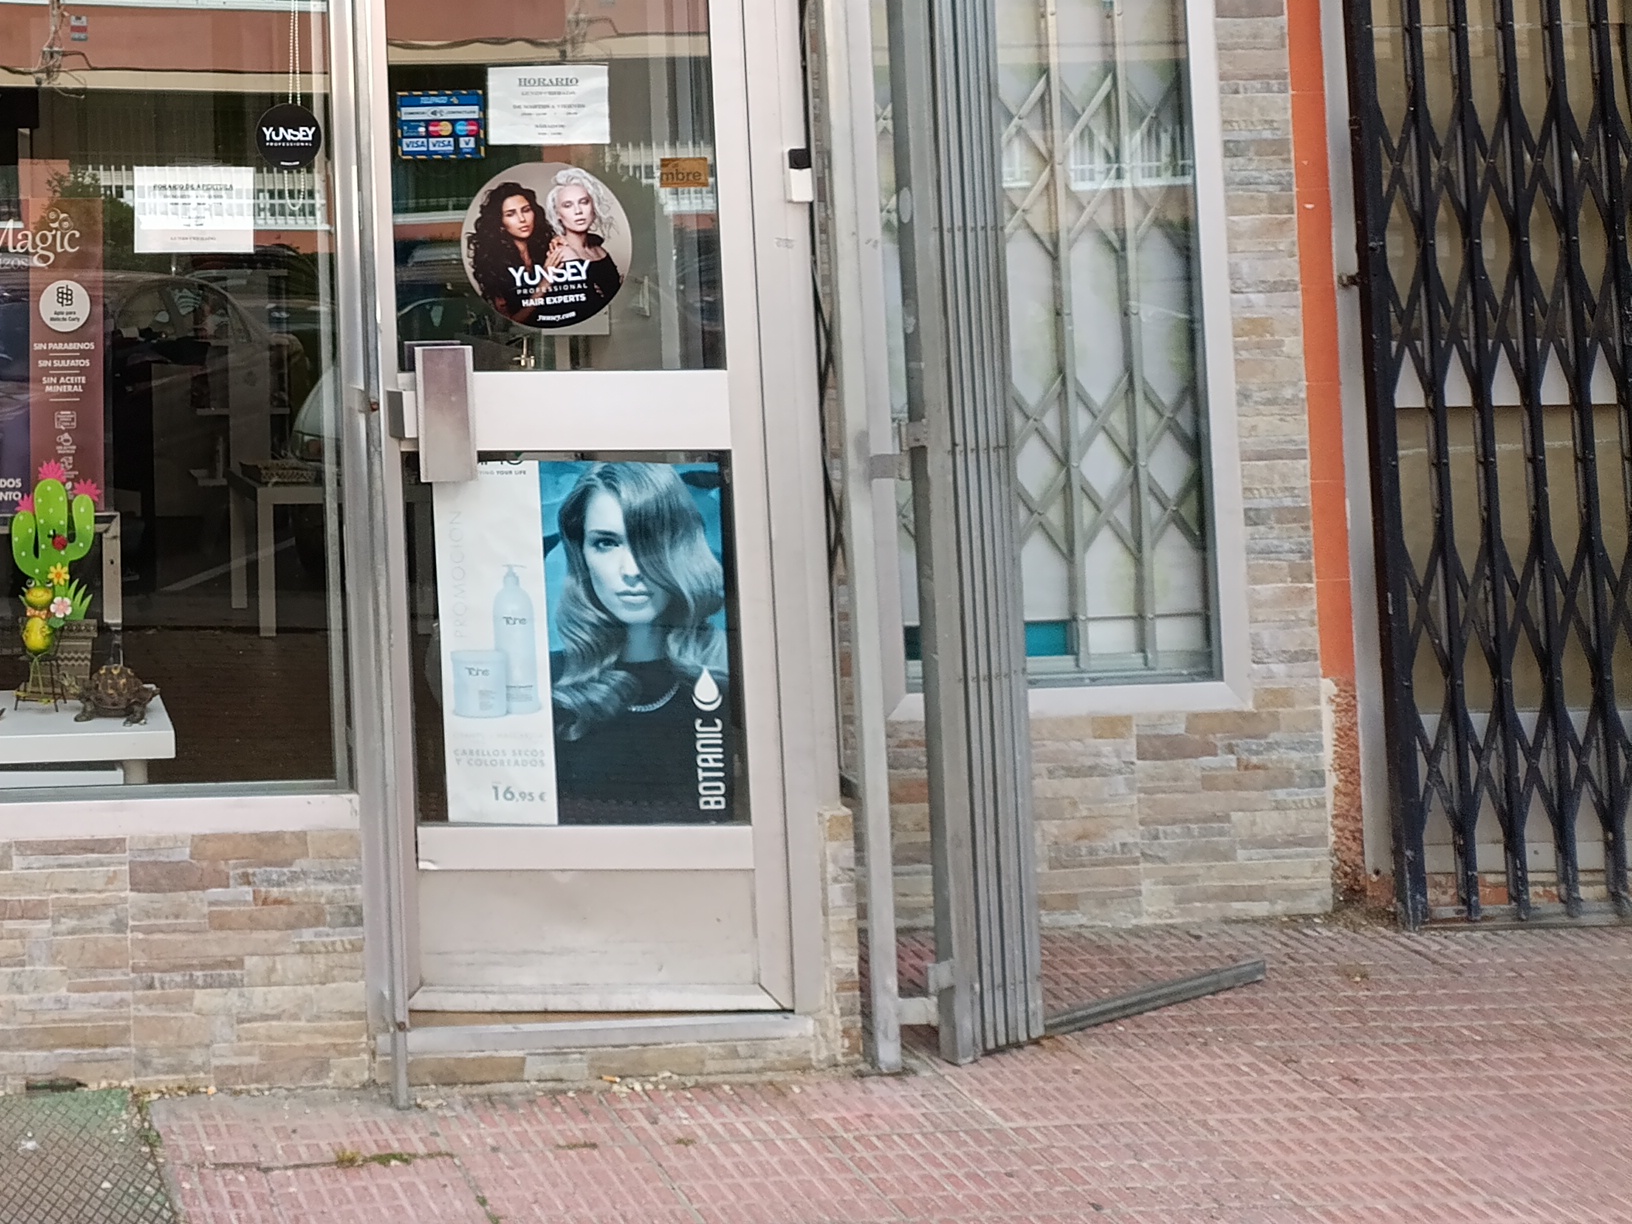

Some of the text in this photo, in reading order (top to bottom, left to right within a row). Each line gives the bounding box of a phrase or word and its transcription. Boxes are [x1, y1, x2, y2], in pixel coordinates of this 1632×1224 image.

[517, 77, 579, 87] HORARIO
[261, 126, 317, 141] YUNSEY
[404, 140, 427, 149] VISA
[431, 139, 453, 148] VISA
[508, 259, 591, 287] YUNSEY
[516, 283, 589, 295] PROFESSIONAL
[521, 293, 587, 308] HAIR EXPERTS
[33, 341, 95, 351] SIN PARABENOS
[37, 358, 90, 368] SIN SULFATOS
[42, 376, 86, 385] SIN ACEITE
[44, 384, 83, 393] MINERAL
[453, 748, 546, 757] CABELLOS SECOS
[467, 758, 546, 767] COLOREADOS
[694, 717, 727, 811] BOTANIC
